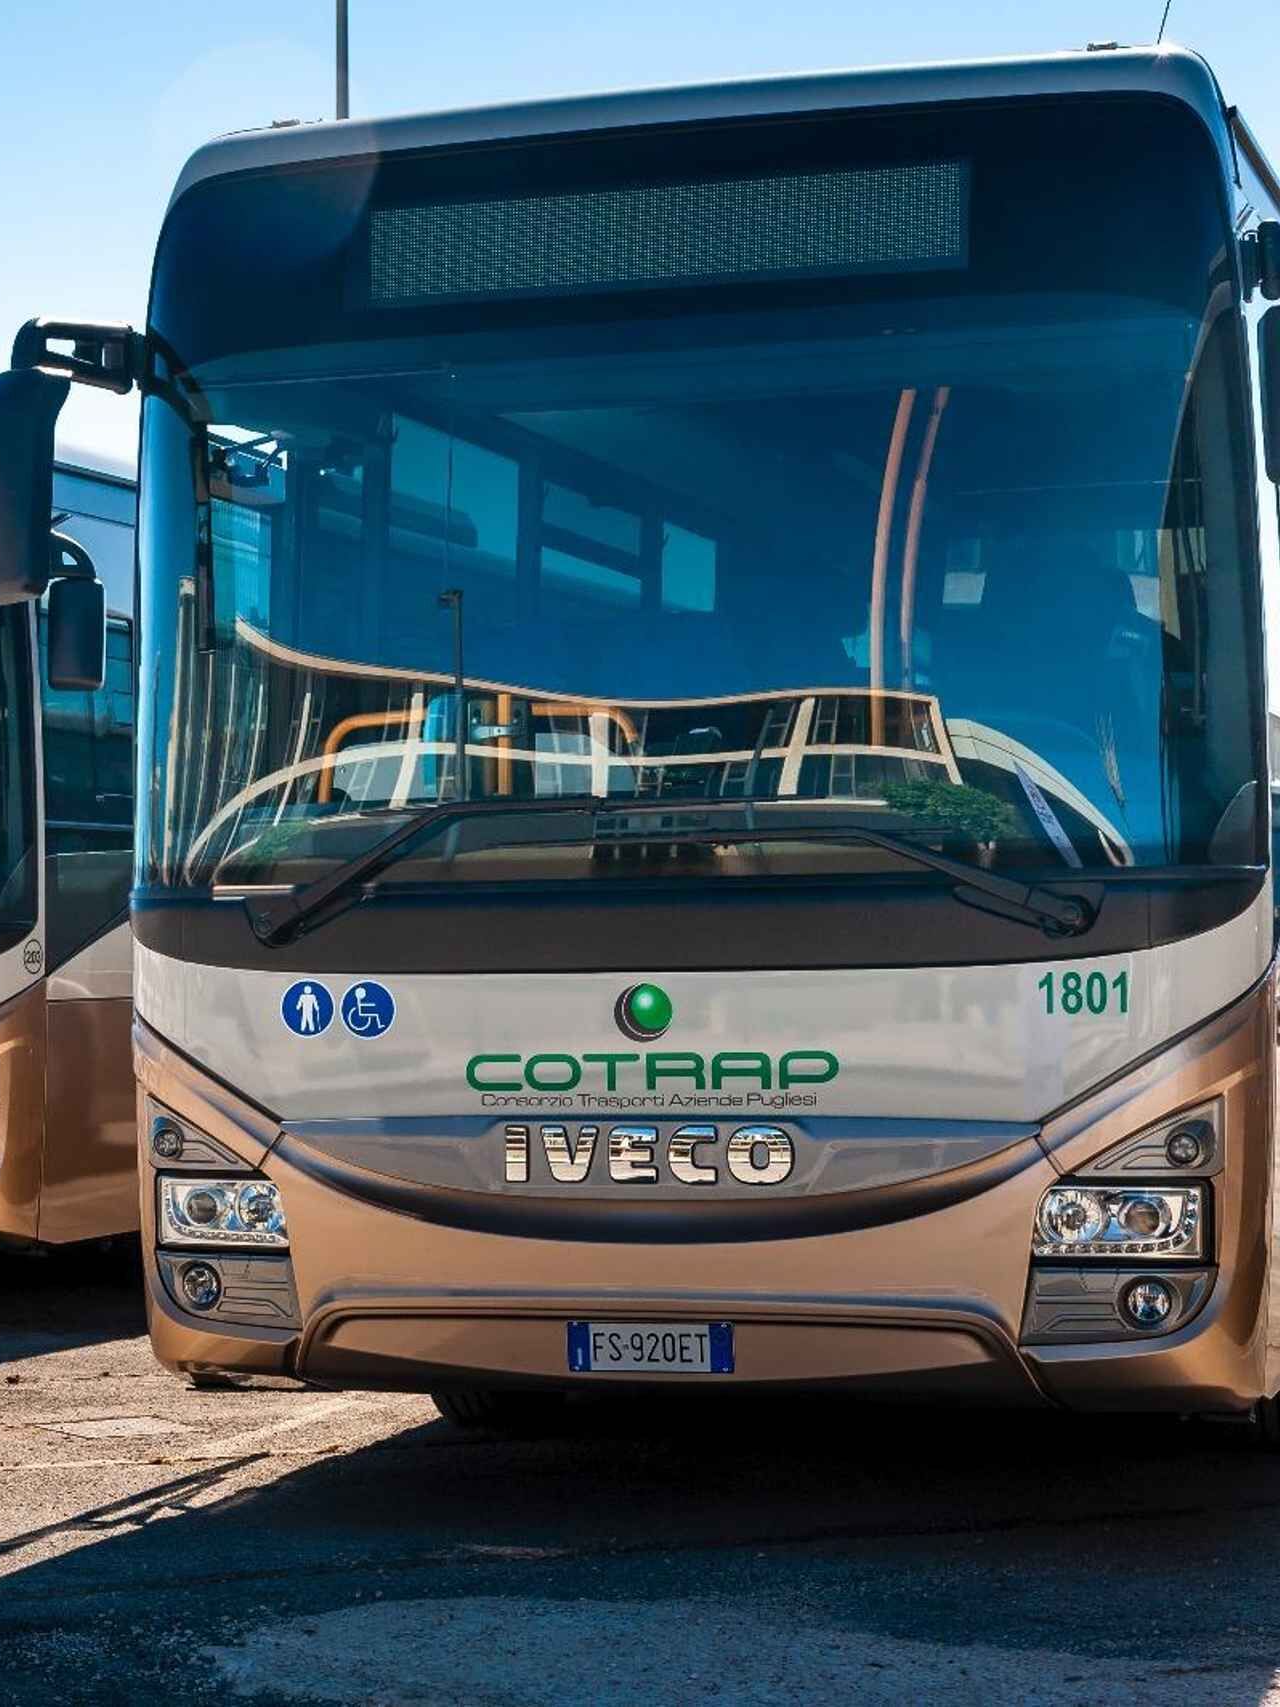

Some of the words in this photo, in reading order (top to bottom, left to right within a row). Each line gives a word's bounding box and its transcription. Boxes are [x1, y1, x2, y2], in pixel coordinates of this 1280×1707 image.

[1038, 971, 1127, 1014] 1801
[466, 1050, 840, 1092] COTRAP
[481, 1094, 574, 1107] Consorzio
[577, 1094, 665, 1109] Trasporti
[669, 1093, 743, 1107] Aziende
[746, 1092, 817, 1109] Pugliesi
[504, 1124, 796, 1186] IVECO
